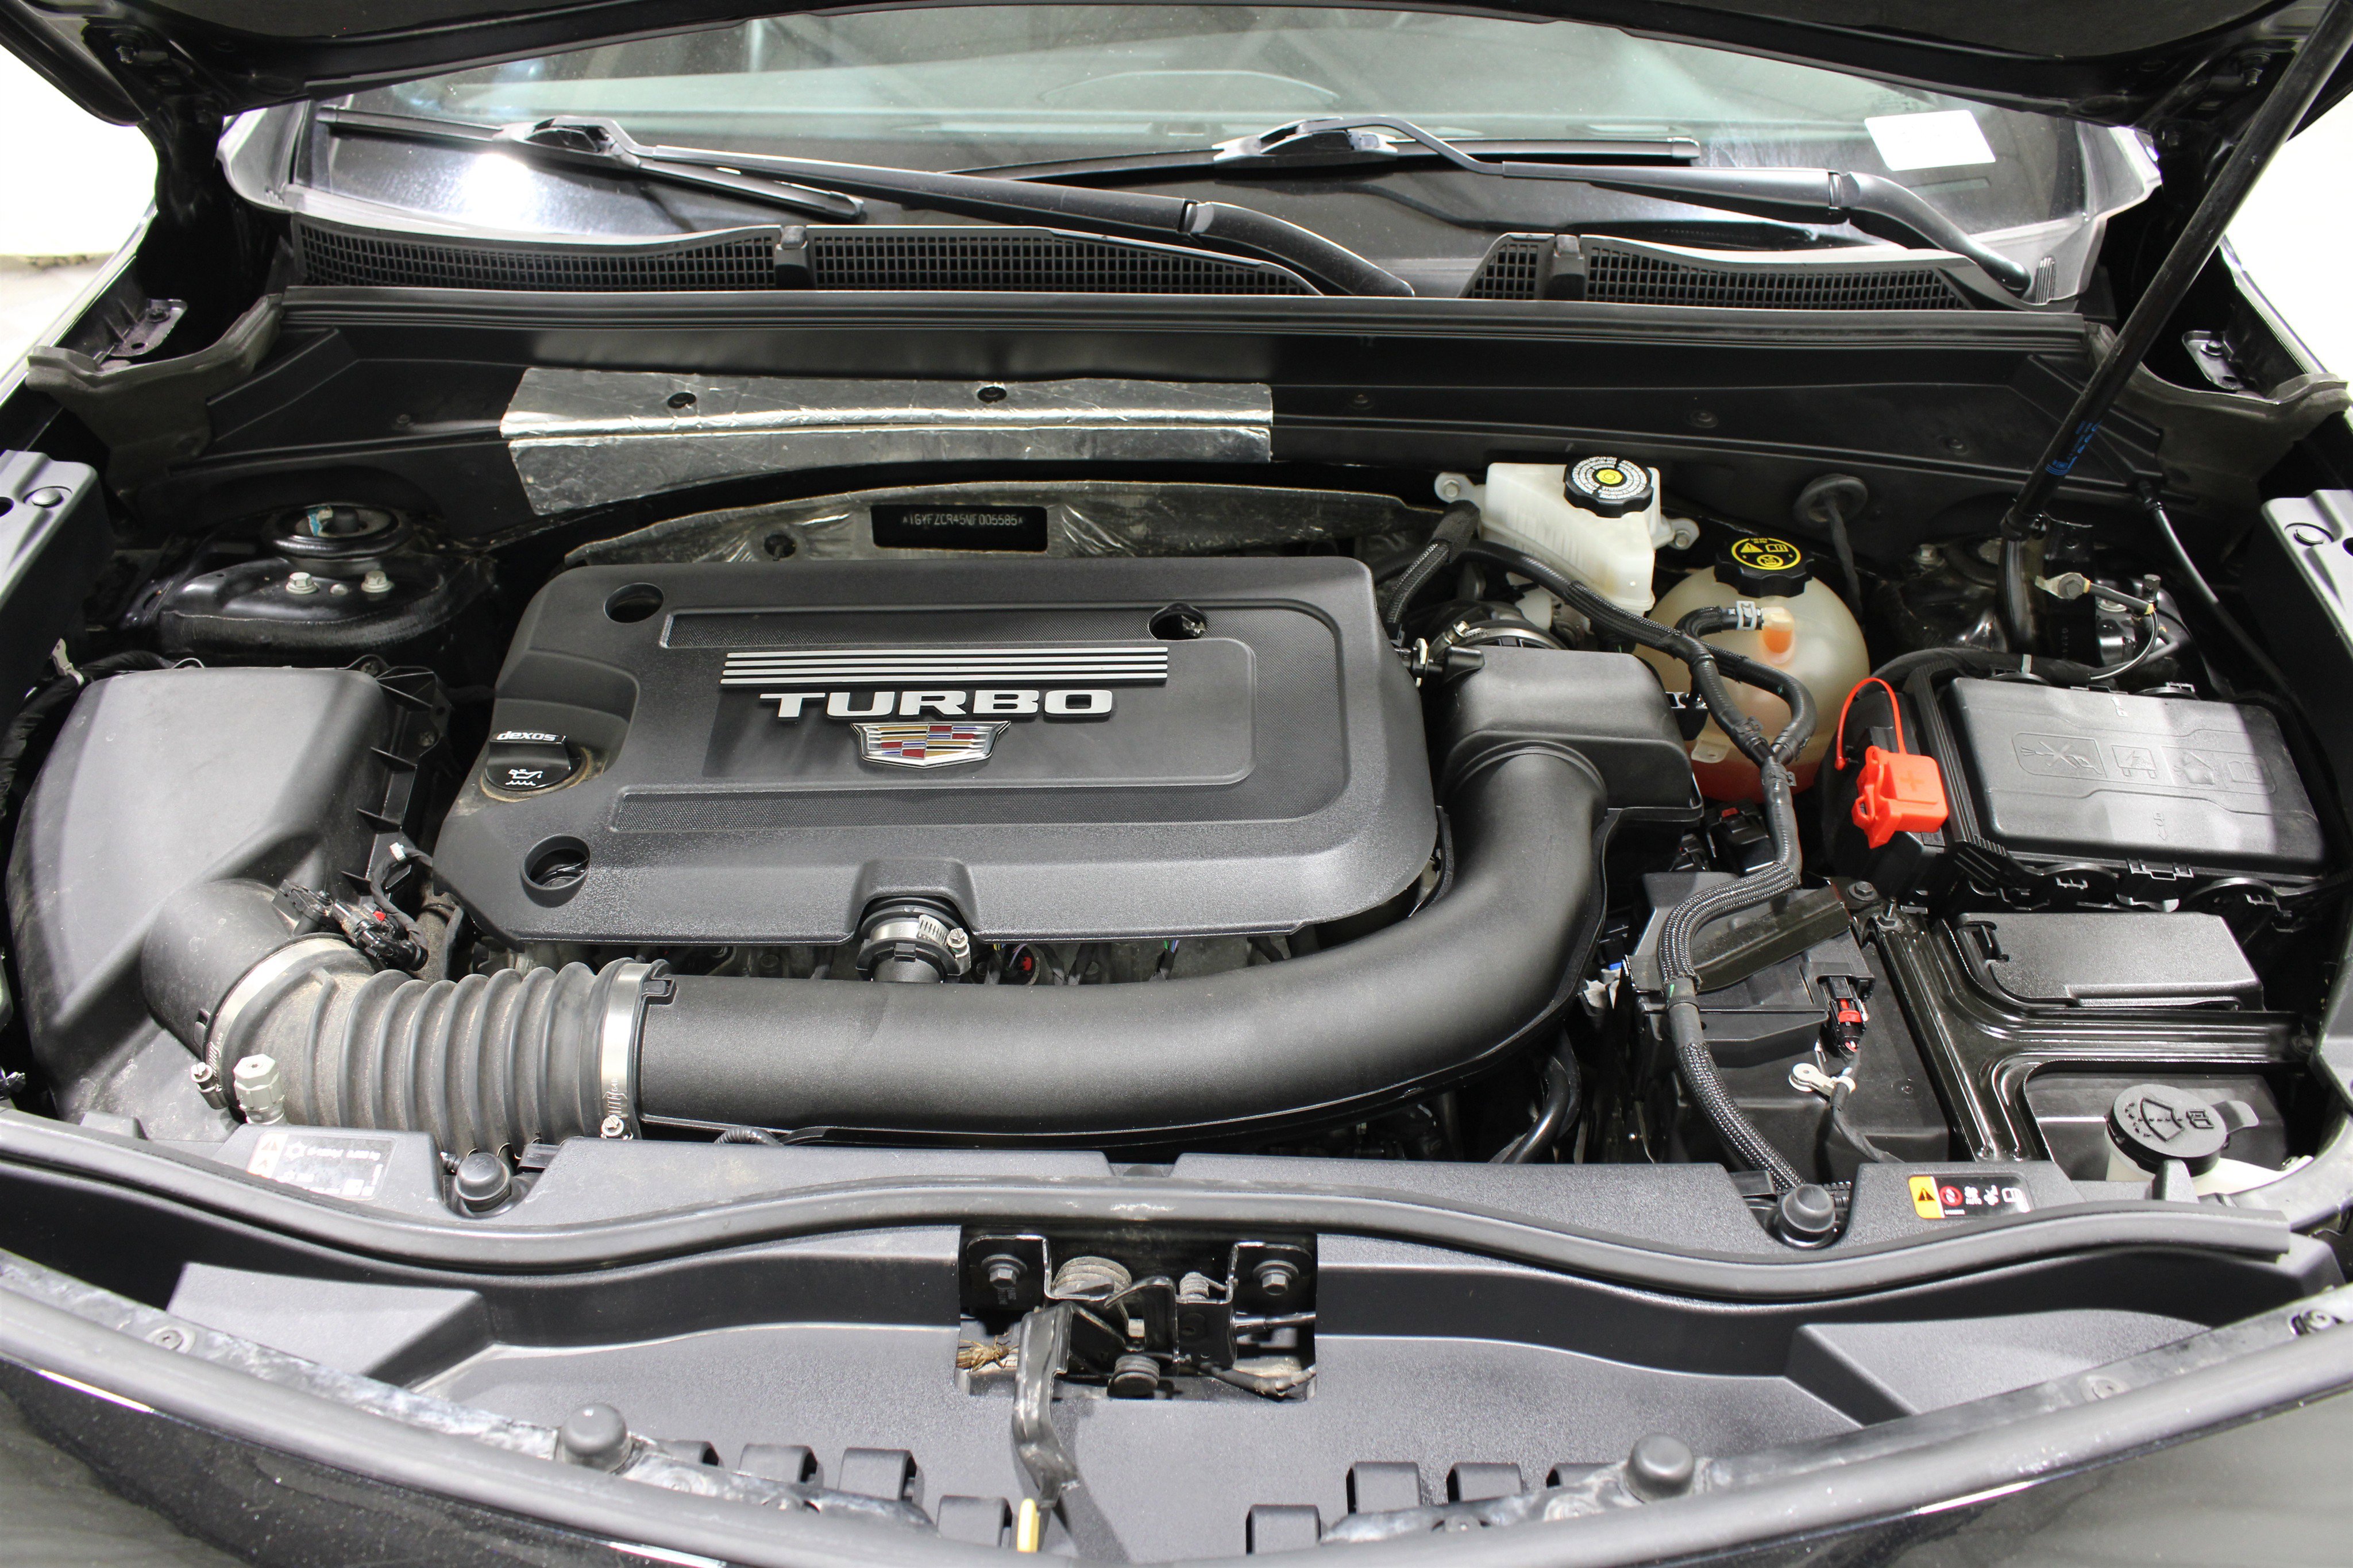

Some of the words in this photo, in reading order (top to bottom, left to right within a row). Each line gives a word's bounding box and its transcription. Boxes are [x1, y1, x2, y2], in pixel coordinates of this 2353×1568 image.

[759, 690, 1113, 718] TURBO
[496, 731, 557, 741] dexos
[1965, 1198, 1982, 1206] AUTO
